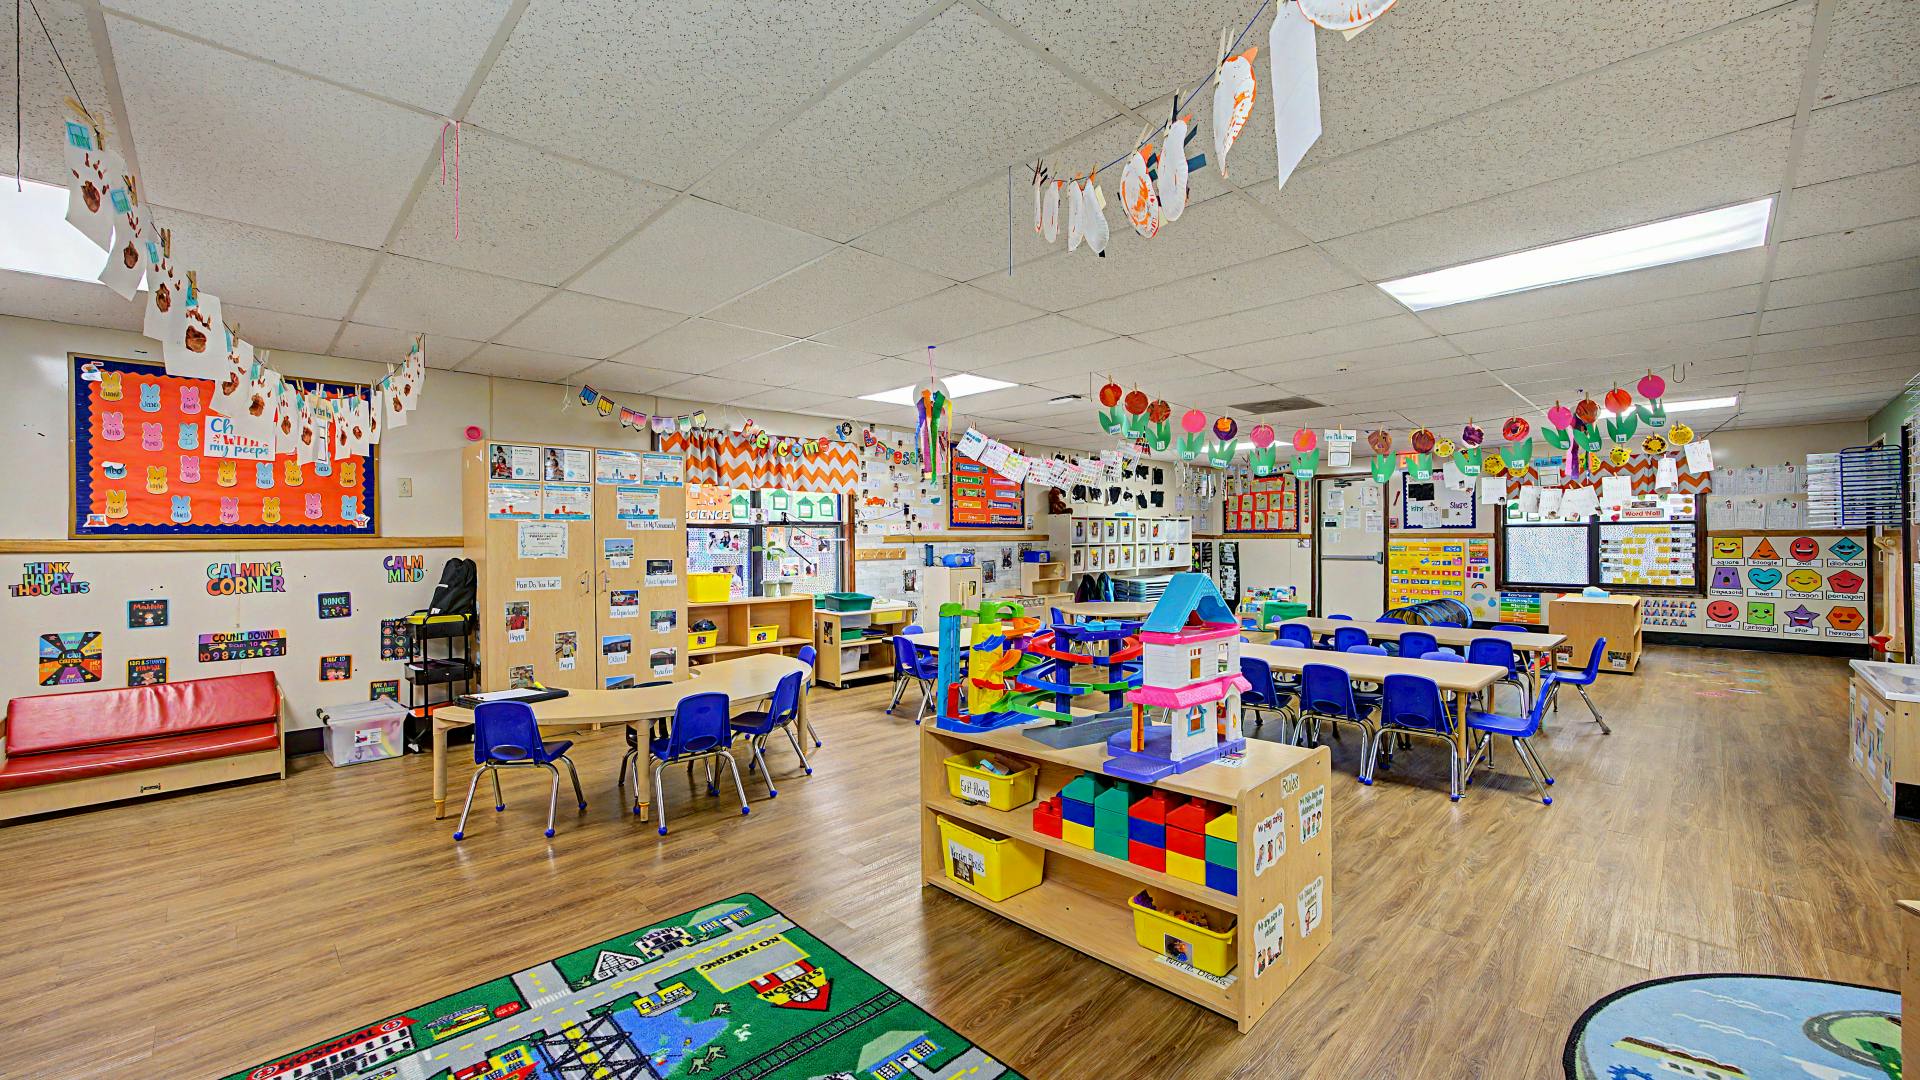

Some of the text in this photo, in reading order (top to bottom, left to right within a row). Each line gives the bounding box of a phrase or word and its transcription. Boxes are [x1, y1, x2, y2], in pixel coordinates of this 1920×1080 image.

[209, 444, 269, 458] my peeps
[24, 562, 70, 574] THINK
[206, 561, 283, 579] CALMING
[383, 555, 424, 571] CALM
[22, 573, 74, 585] HAPPY
[387, 568, 424, 583] MIND
[8, 582, 91, 598] THOUGHTS
[206, 576, 286, 596] CORNER
[528, 580, 537, 588] Do
[322, 597, 346, 606] DANCE
[212, 630, 274, 642] COUNT DOWN
[200, 647, 285, 661] 10 9 8 7 6 5 4 3 2 1
[700, 936, 780, 971] NO PARKING
[763, 969, 823, 999] STATION
[278, 1029, 376, 1070] HOSPITAL
